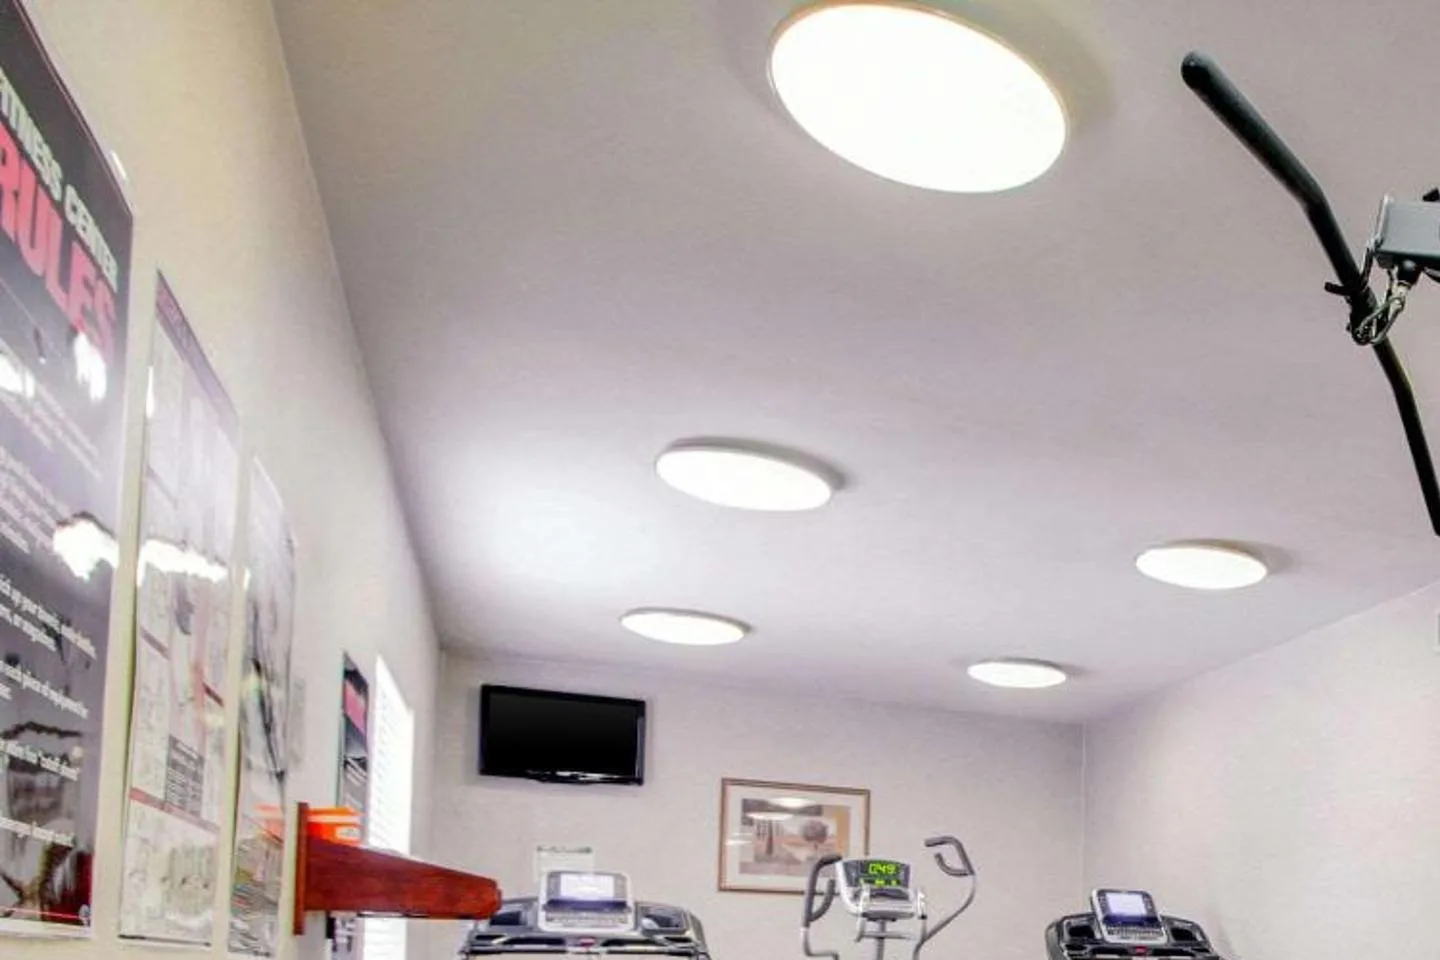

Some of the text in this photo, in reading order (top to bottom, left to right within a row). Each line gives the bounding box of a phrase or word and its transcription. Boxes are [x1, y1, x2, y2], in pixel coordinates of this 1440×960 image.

[0, 64, 119, 295] ITNESS CENTER
[0, 119, 117, 366] RULES
